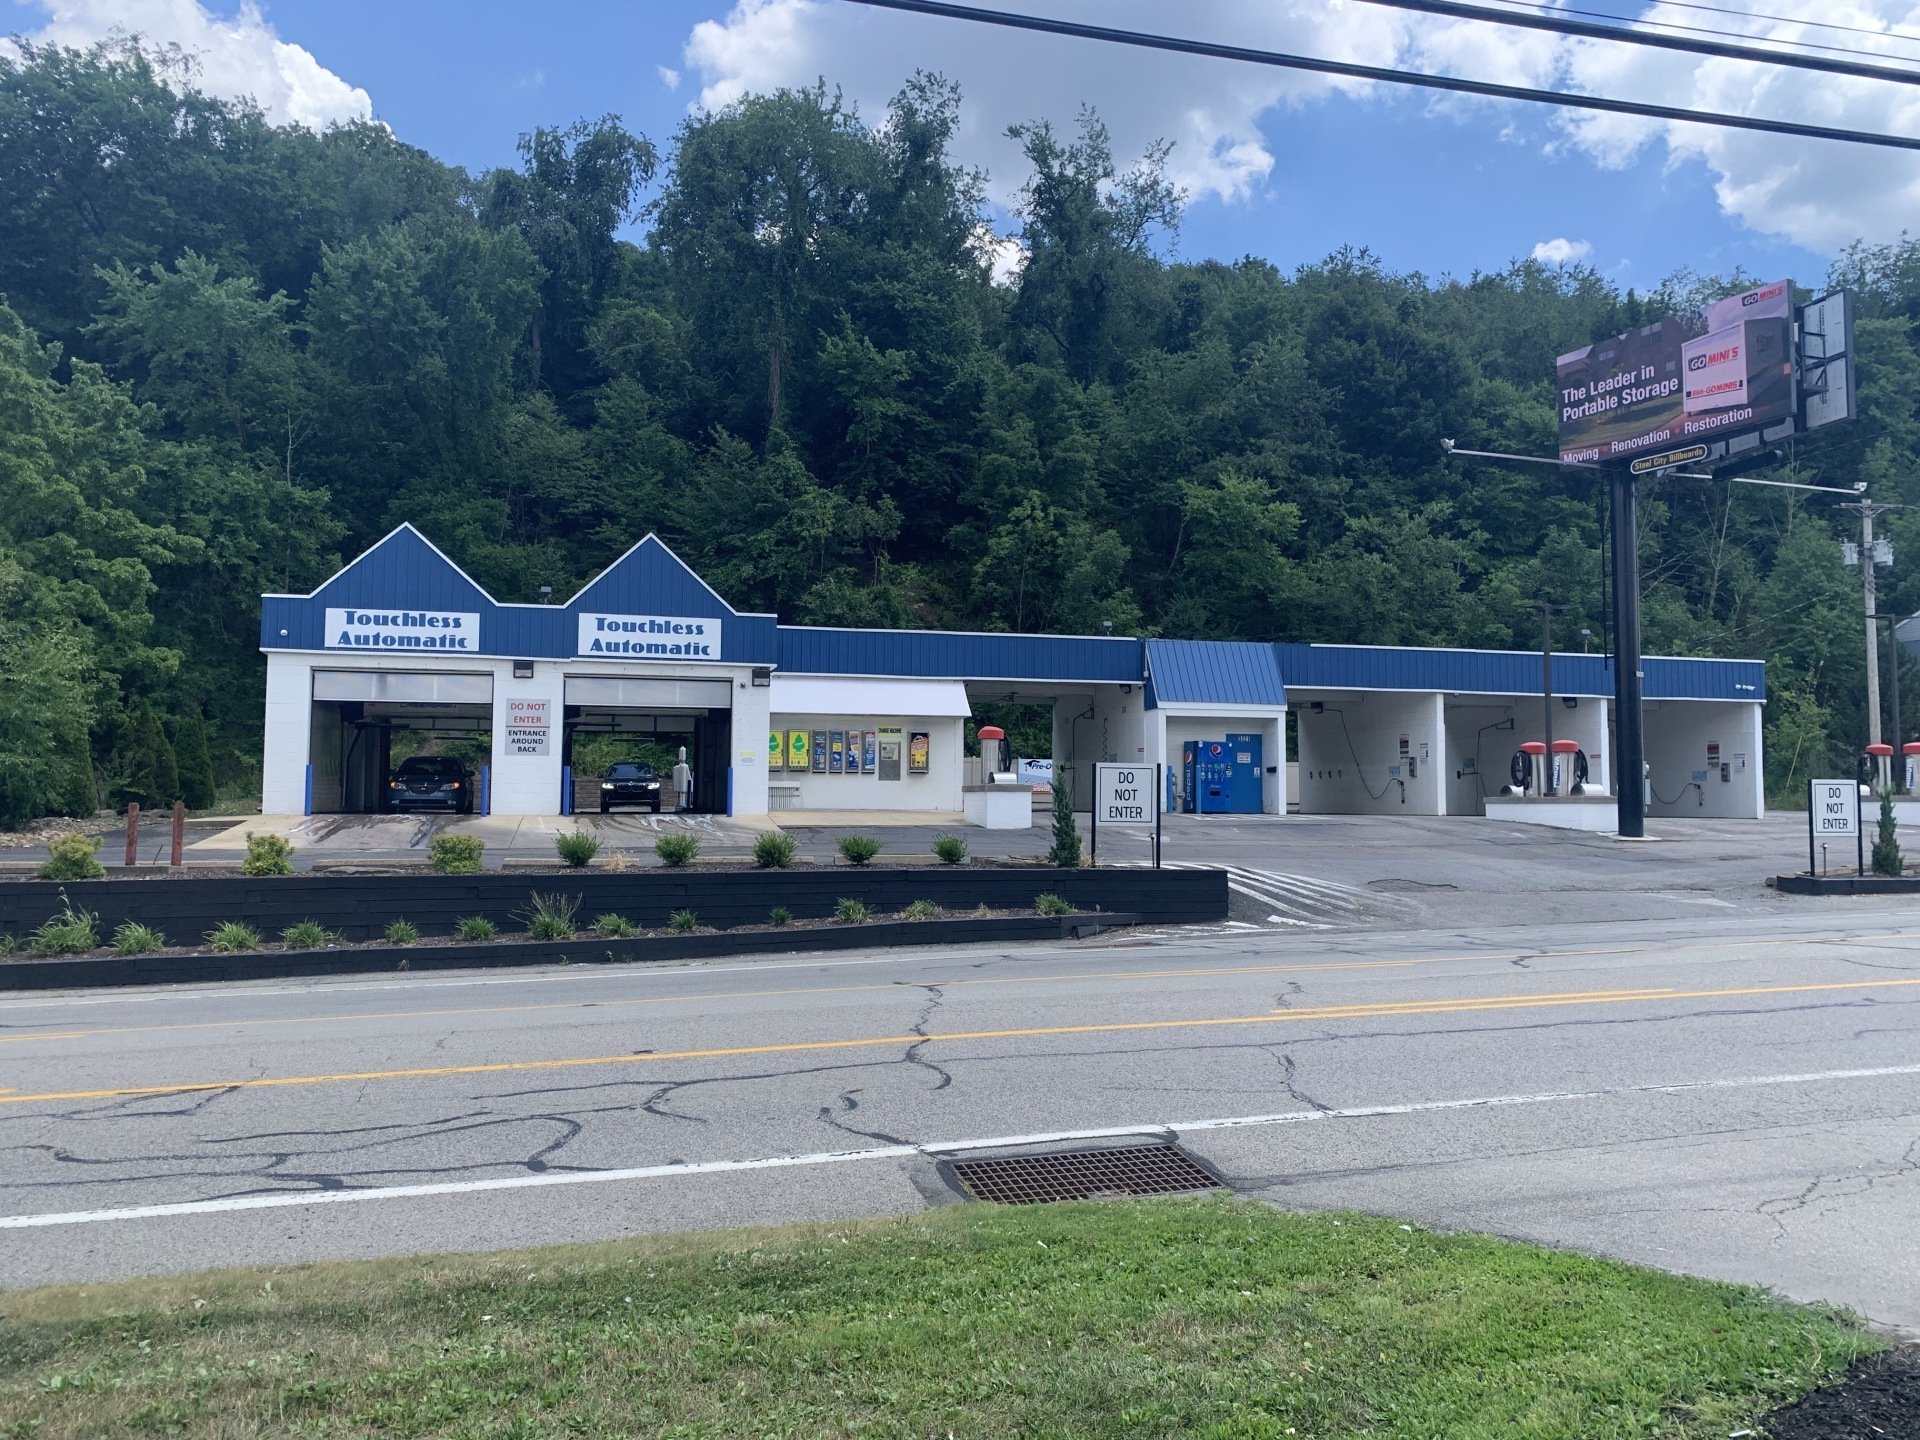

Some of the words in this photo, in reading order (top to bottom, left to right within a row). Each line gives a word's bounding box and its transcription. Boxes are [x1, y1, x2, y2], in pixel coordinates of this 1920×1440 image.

[1744, 294, 1758, 305] GO
[1691, 357, 1706, 370] GO
[1562, 387, 1586, 404] The
[1590, 371, 1637, 396] Leader
[1641, 365, 1655, 380] in
[1563, 395, 1618, 422] Portable
[1622, 378, 1679, 405] Storage
[1563, 448, 1600, 466] Moving
[1611, 428, 1670, 453] Renovation
[1684, 407, 1752, 435] Restoration
[1634, 460, 1652, 471] Steel
[1653, 456, 1667, 468] City
[1669, 449, 1703, 463] Billboards
[344, 610, 462, 629] Touchless
[595, 617, 704, 635] Touchless
[337, 630, 468, 649] Automatic
[590, 638, 711, 656] Automatic
[510, 702, 524, 711] DO
[527, 703, 547, 711] NOT
[513, 716, 542, 724] ENTER
[508, 729, 547, 737] ENTRANCE
[1118, 771, 1135, 784] DO
[1114, 788, 1139, 801] NOT
[1828, 787, 1841, 799] DO
[1109, 806, 1143, 819] ENTER
[1826, 802, 1845, 814] NOT
[1822, 818, 1848, 830] ENTER
